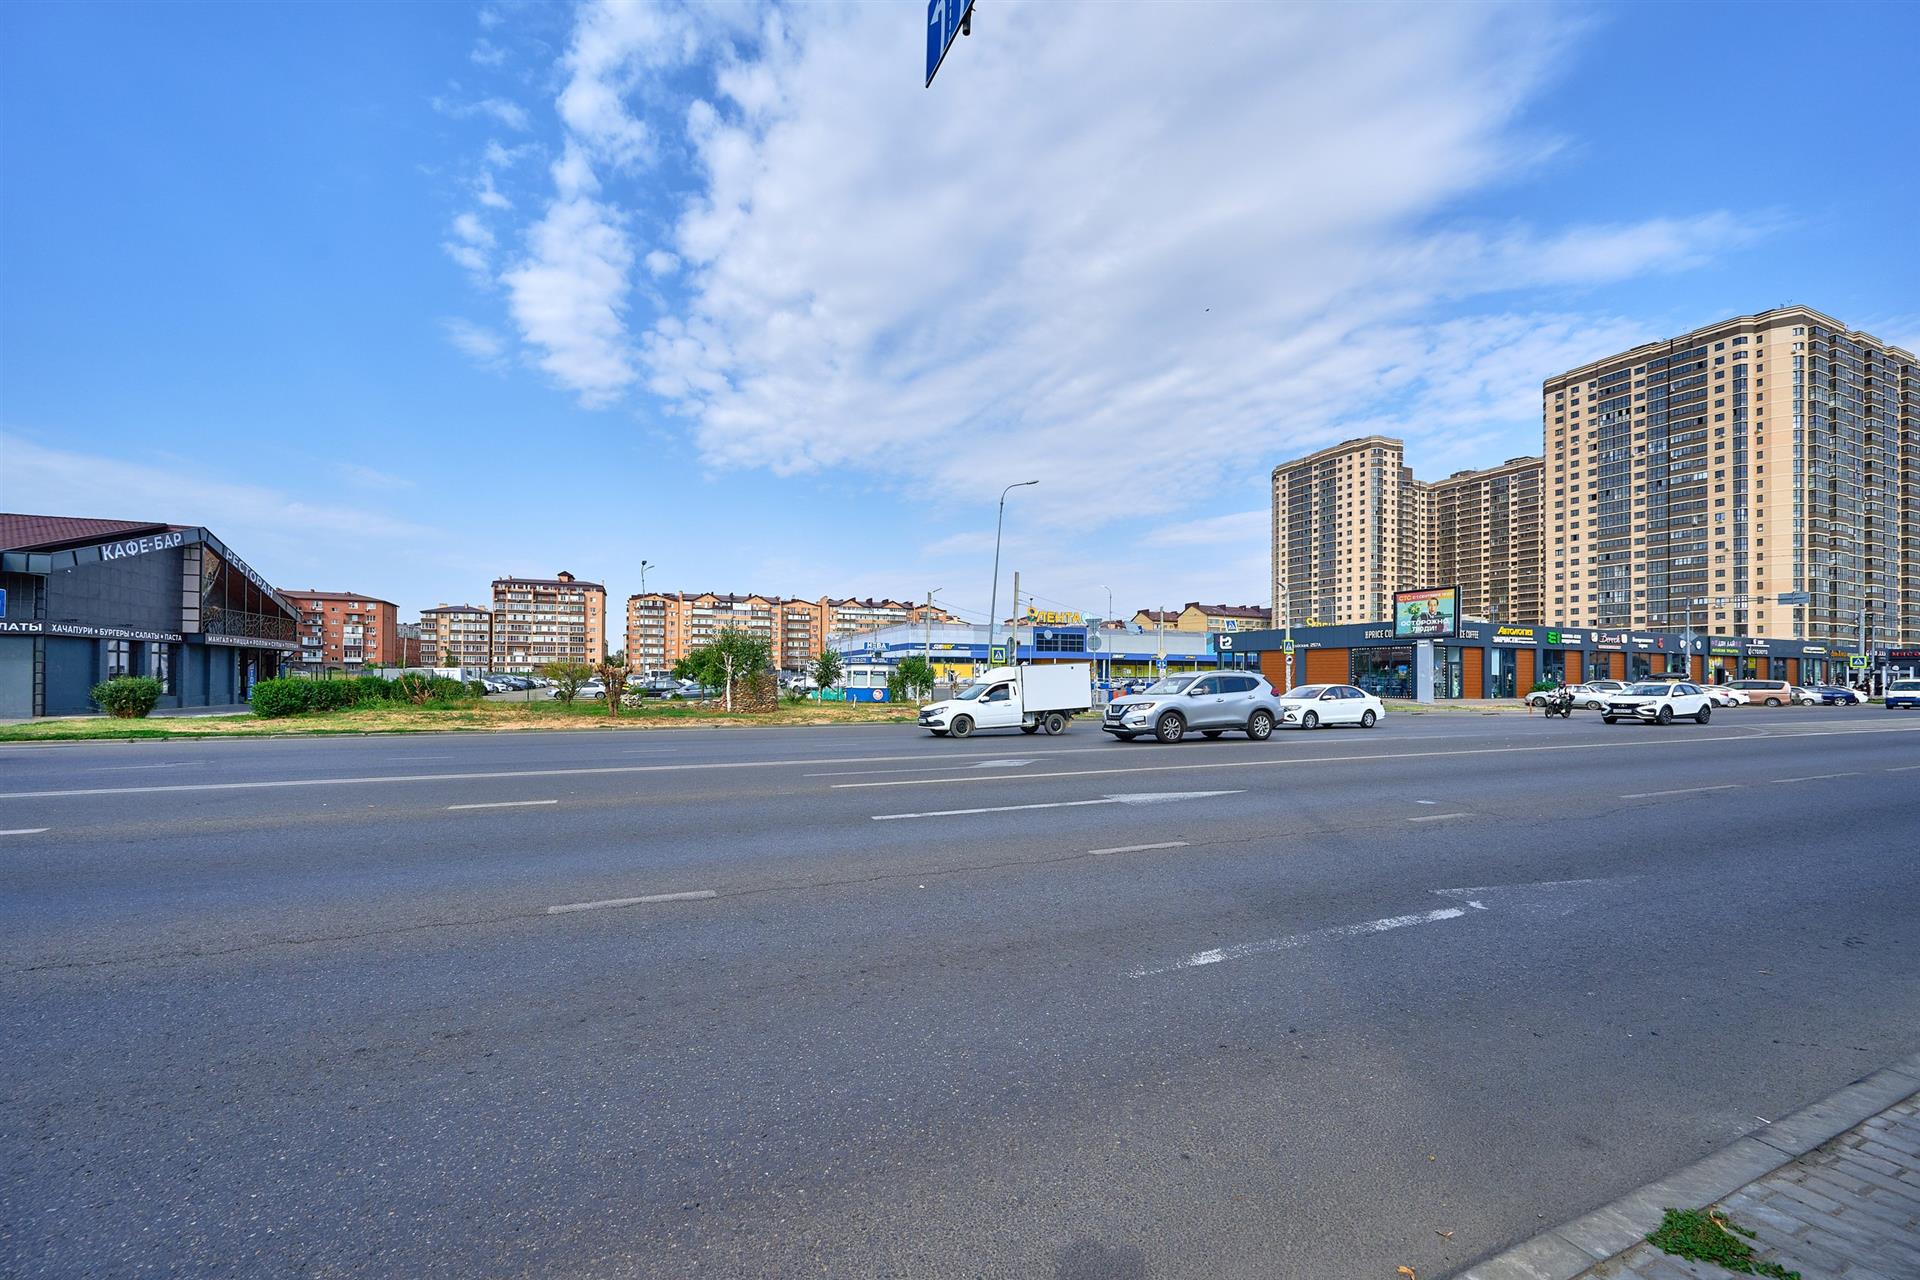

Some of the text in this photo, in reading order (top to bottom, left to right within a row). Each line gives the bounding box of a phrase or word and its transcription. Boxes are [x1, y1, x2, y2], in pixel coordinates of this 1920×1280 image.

[102, 532, 182, 561] КАФЕ-БАР
[226, 549, 274, 598] РЕСТОРАН
[1036, 611, 1081, 624] ЛЕНТА
[51, 623, 182, 641] ХАЧАПУРИ БУРГЕРЫ САЛАТЫ ПАСТА
[1368, 630, 1384, 639] PRICE
